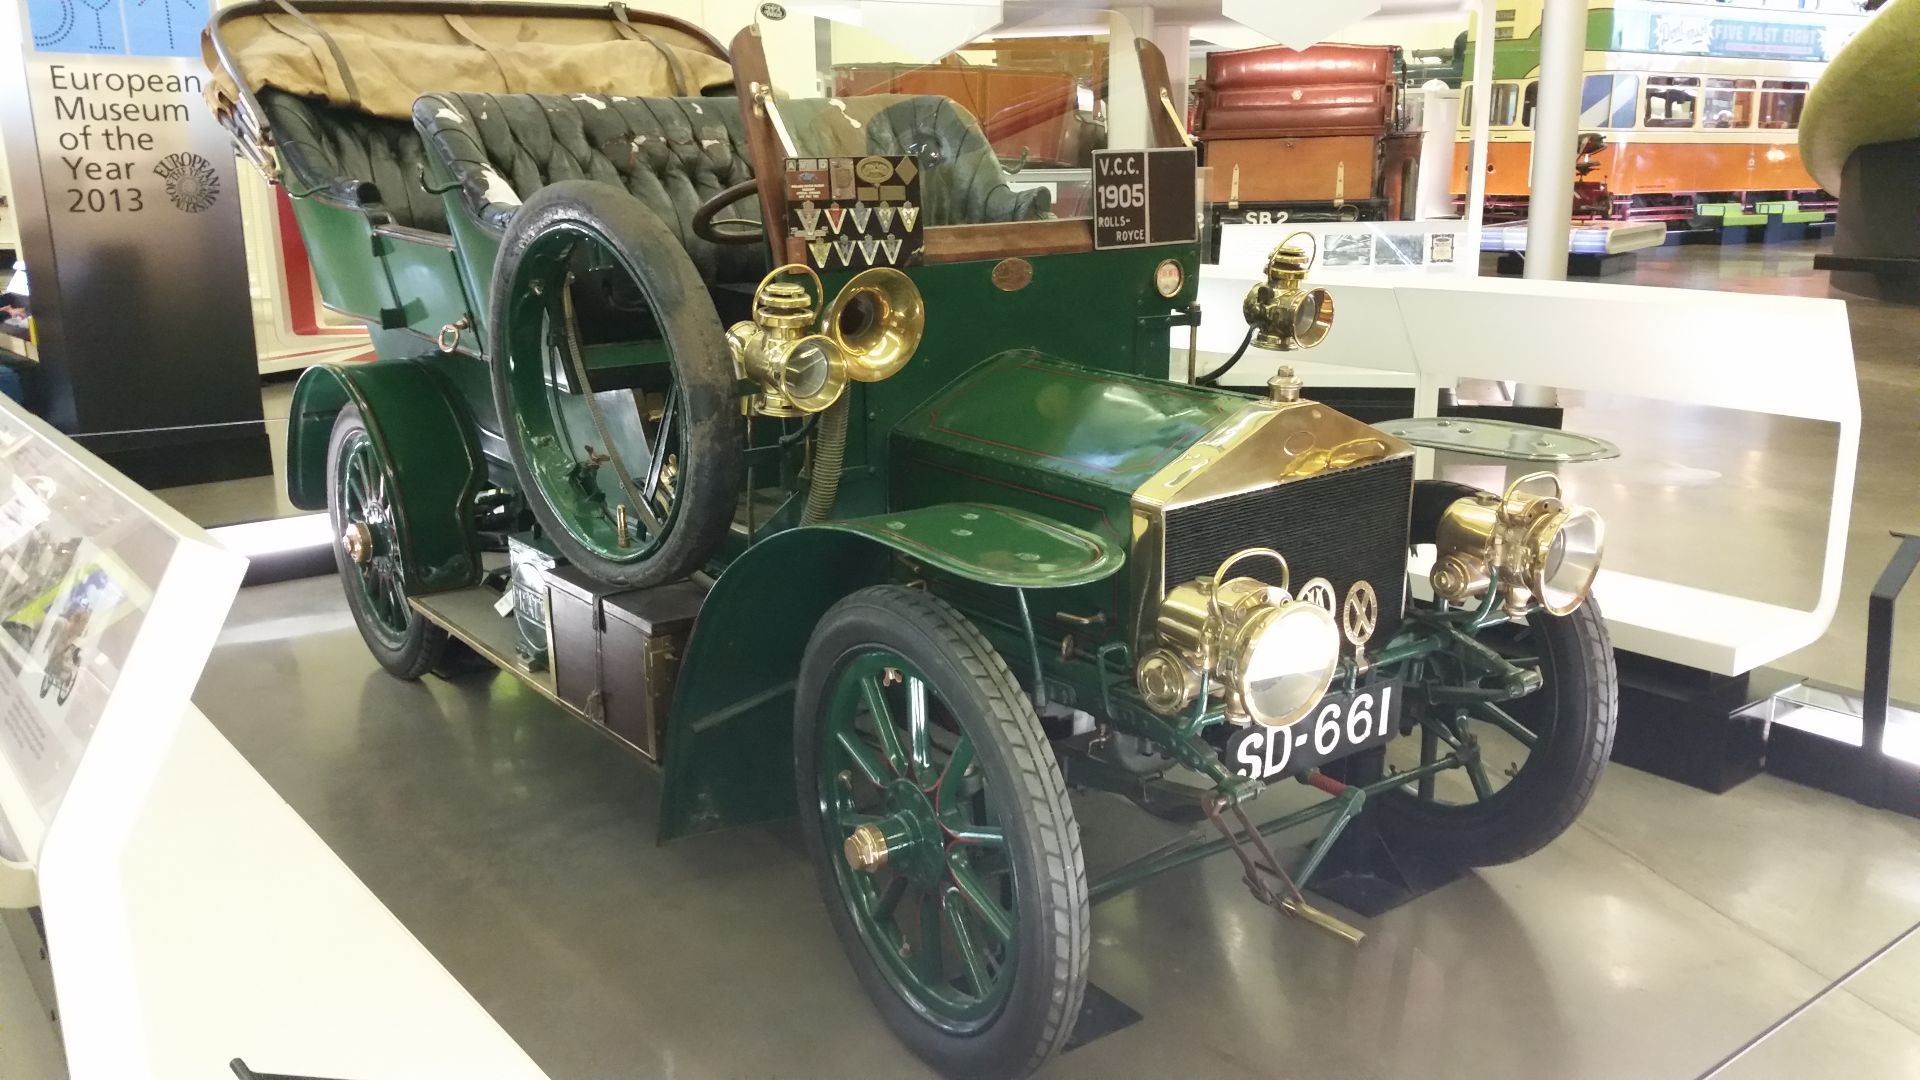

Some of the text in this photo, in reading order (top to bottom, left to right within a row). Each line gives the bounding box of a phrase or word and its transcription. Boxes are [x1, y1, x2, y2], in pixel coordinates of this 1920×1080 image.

[1715, 24, 1817, 45] FIVE PAST EIGHT
[50, 65, 201, 98] European
[55, 96, 189, 121] Museum
[59, 125, 153, 150] of the
[61, 156, 135, 180] Year
[153, 152, 220, 186] EUROPEAN
[1099, 157, 1139, 176] V.C.C.
[67, 188, 144, 213] 2013
[1098, 183, 1144, 209] 1905
[1098, 216, 1131, 228] ROLLS-
[1116, 229, 1145, 242] ROYCE
[1237, 687, 1391, 779] SD-661
